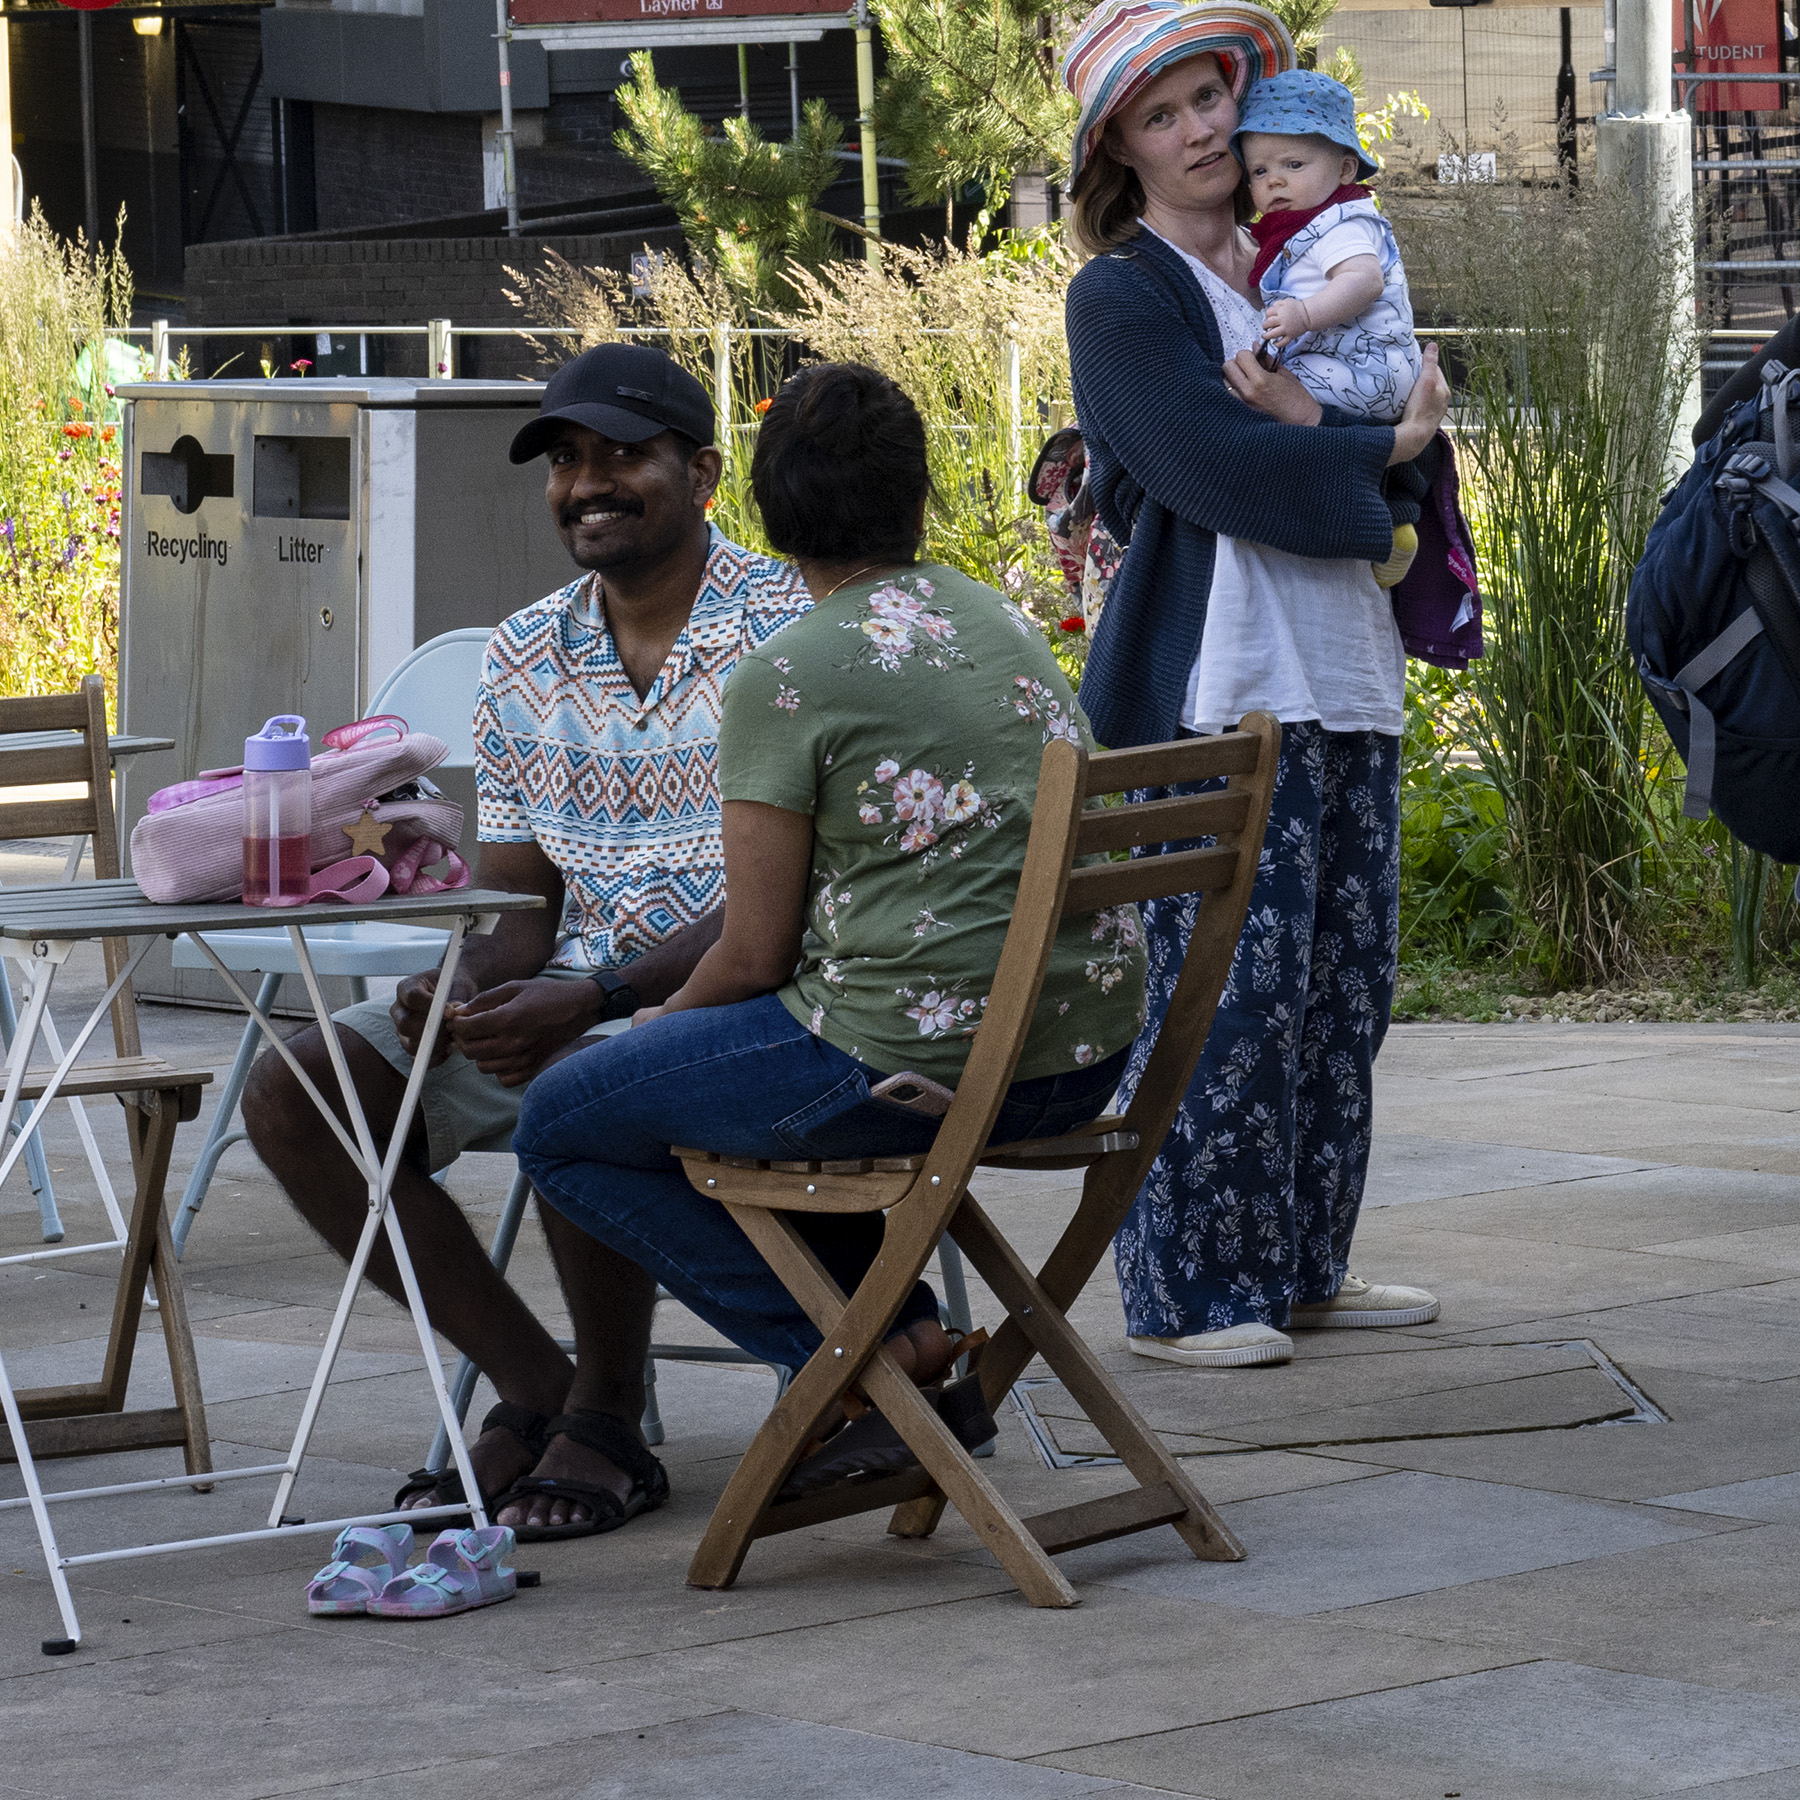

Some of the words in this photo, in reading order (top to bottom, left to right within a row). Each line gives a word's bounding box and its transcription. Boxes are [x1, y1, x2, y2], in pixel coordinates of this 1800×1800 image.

[1695, 45, 1766, 60] TUDENT
[147, 531, 228, 566] Recycling
[279, 536, 324, 563] Litter
